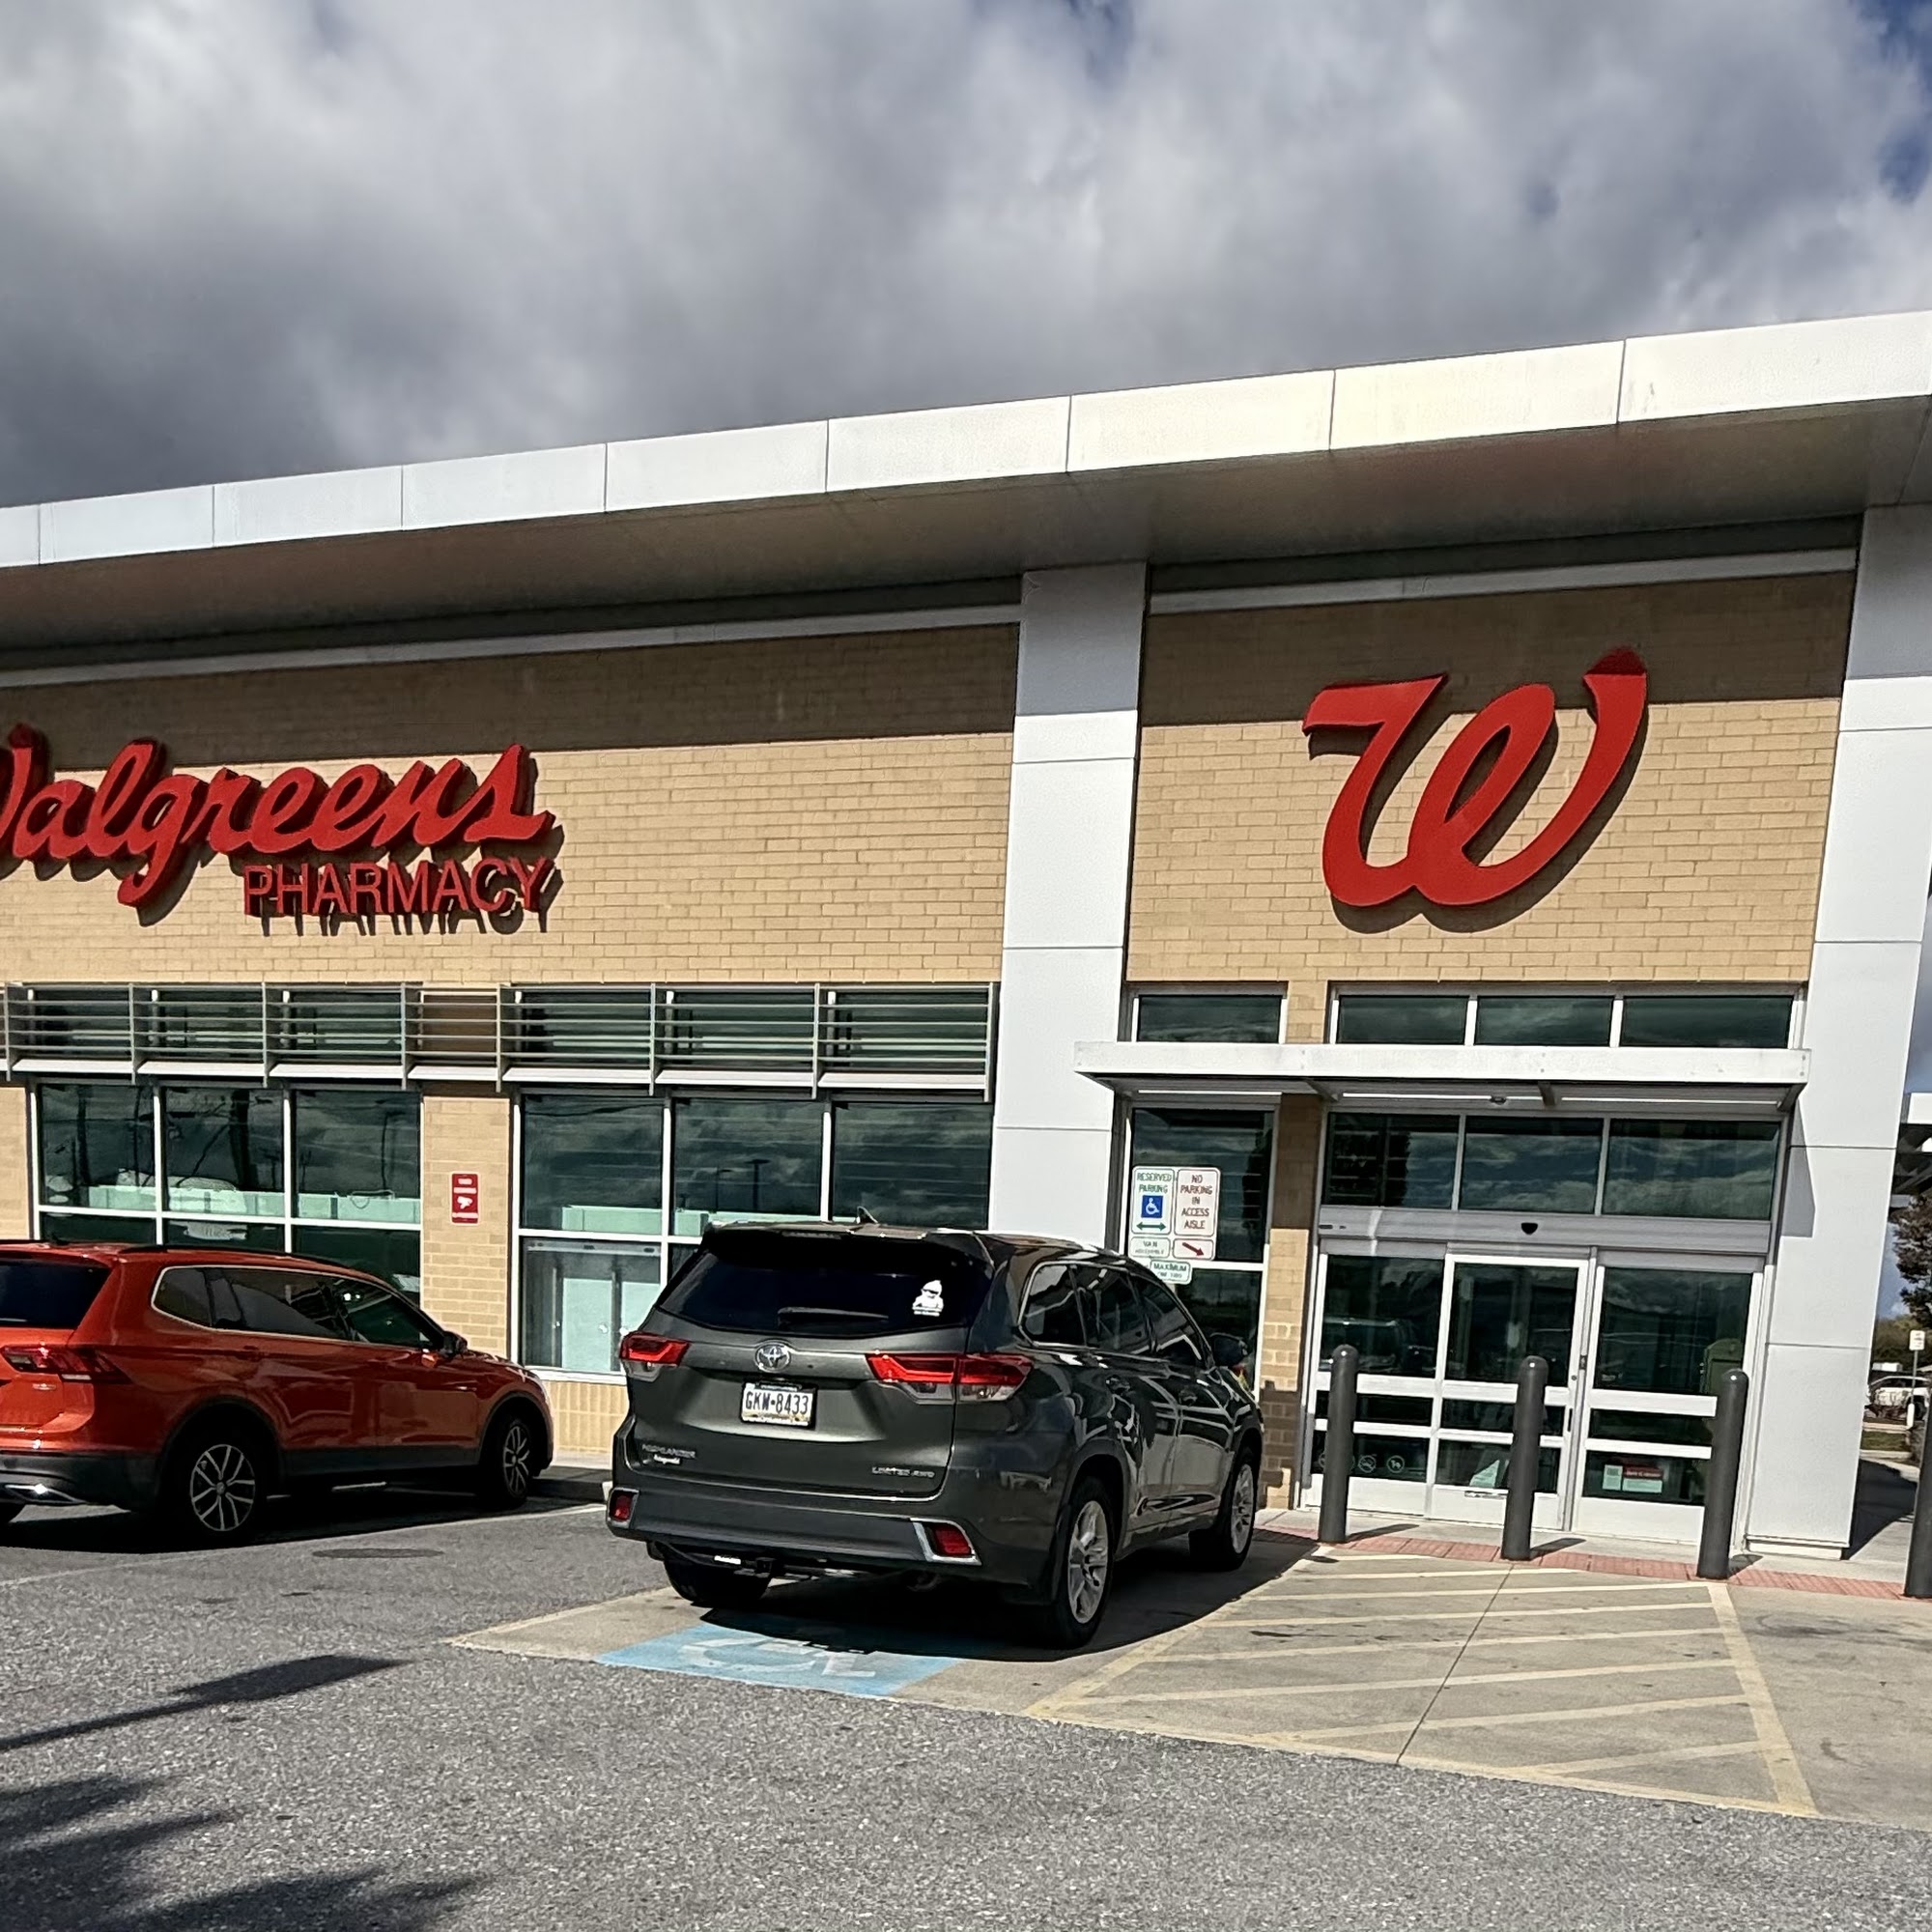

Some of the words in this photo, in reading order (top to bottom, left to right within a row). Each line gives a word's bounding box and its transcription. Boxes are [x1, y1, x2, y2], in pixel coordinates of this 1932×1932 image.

[1302, 645, 1648, 907] W
[244, 857, 554, 917] PHARMACY
[1137, 1172, 1172, 1181] RESERVED
[1191, 1174, 1203, 1183] NO
[1139, 1183, 1168, 1194] PARKING
[1180, 1184, 1212, 1195] PARKING
[1191, 1196, 1200, 1205] IN
[1181, 1208, 1209, 1217] ACCESS
[1184, 1219, 1206, 1229] AISLE
[1153, 1263, 1187, 1271] MAXIMUM
